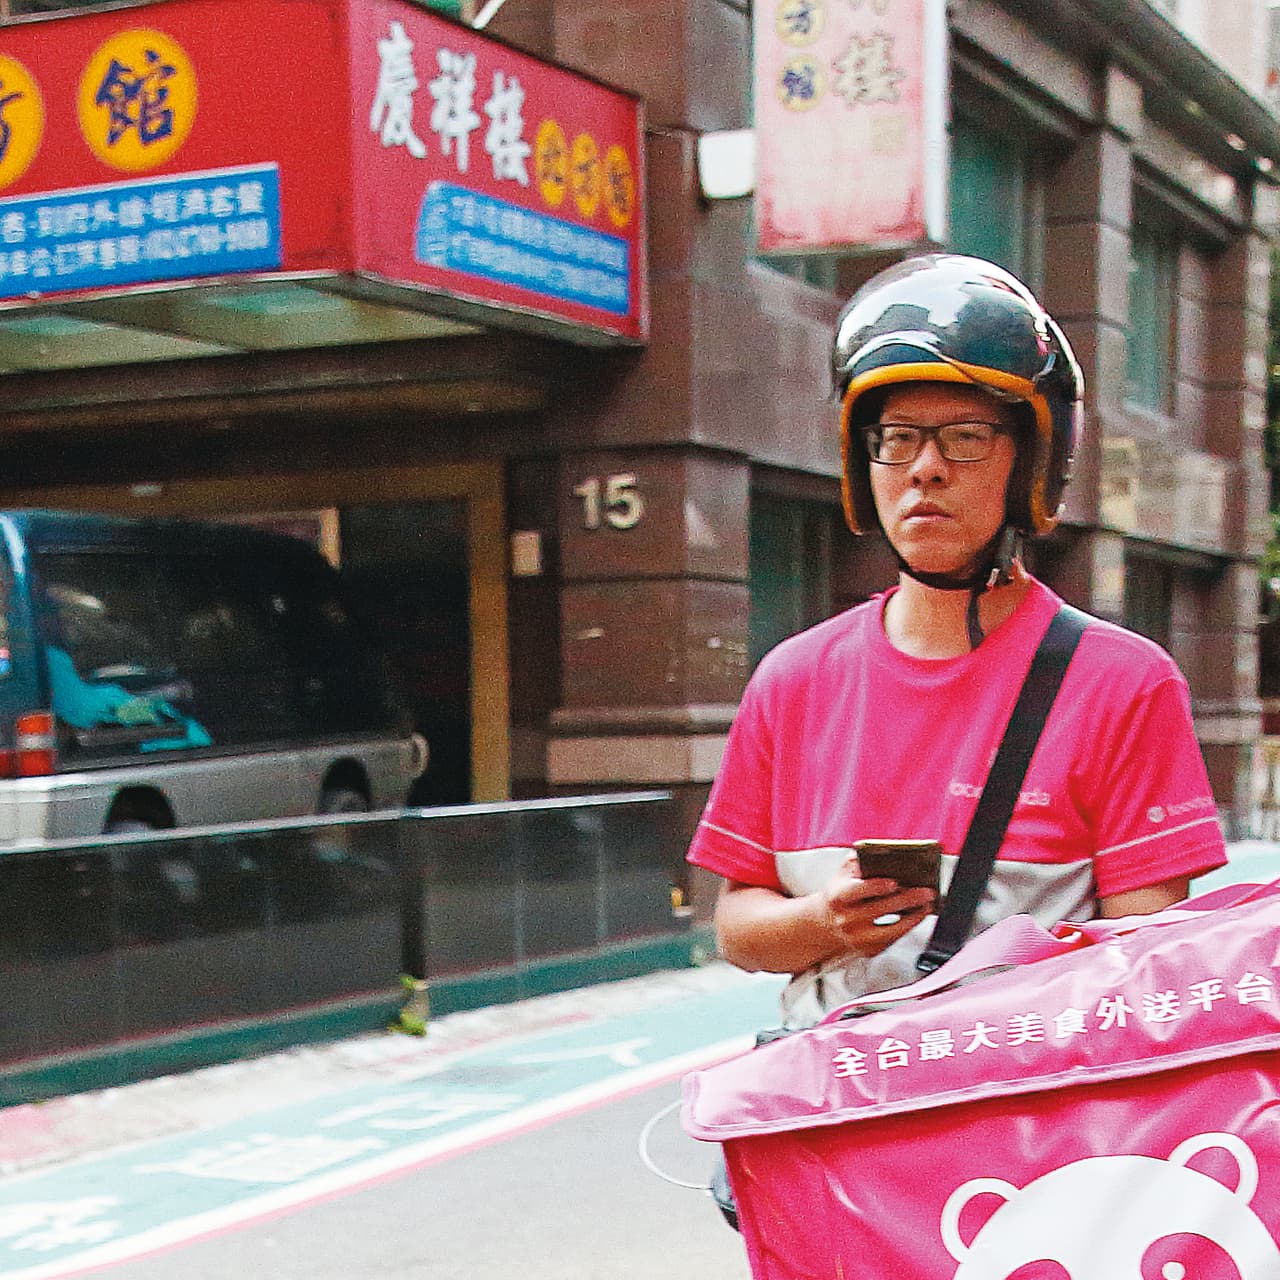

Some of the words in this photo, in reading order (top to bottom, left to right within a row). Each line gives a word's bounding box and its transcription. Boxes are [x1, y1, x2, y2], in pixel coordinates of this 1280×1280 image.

[574, 470, 644, 531] 15
[831, 971, 1274, 1079] 全台最大美食外送平台
